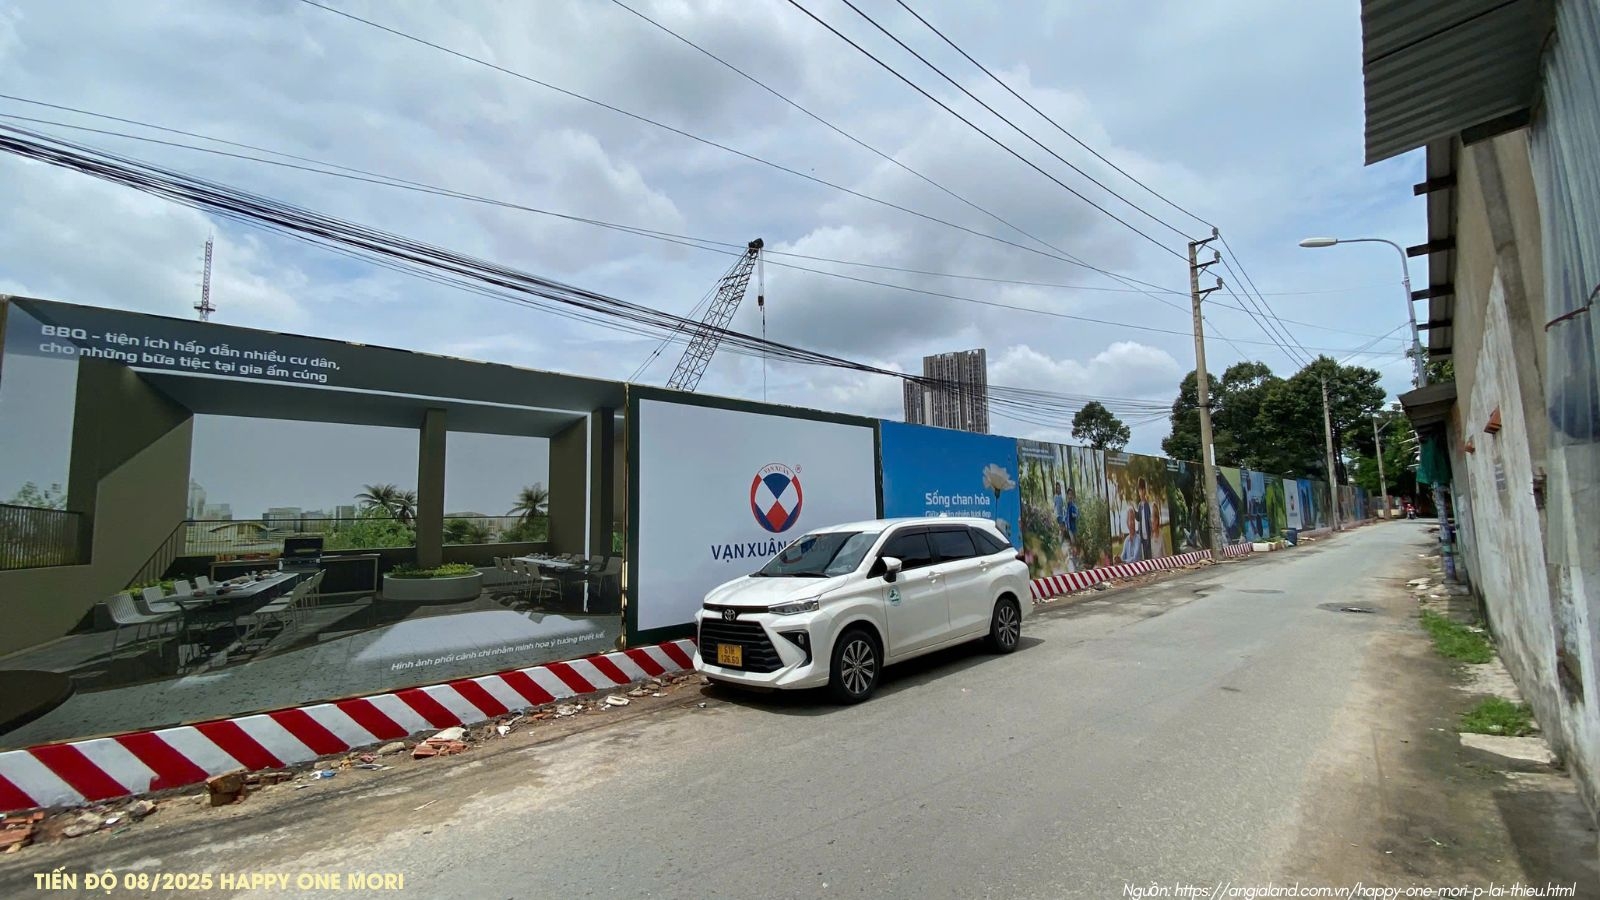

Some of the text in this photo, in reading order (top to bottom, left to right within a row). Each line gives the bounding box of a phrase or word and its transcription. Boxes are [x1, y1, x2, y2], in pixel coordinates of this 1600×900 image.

[41, 325, 87, 340] BBQ
[105, 332, 140, 346] tiện
[144, 337, 169, 349] ích
[174, 340, 206, 355] hấp
[209, 344, 240, 358] dẫn
[244, 350, 286, 363] nhiều
[290, 355, 308, 366] cư
[310, 358, 341, 371] dân,
[39, 342, 328, 383] cho những bữa tiệc tại gia ấm cúng
[925, 489, 991, 508] Sống chan hòa
[711, 537, 787, 563] VẠN XUÂN
[515, 643, 534, 652] minh
